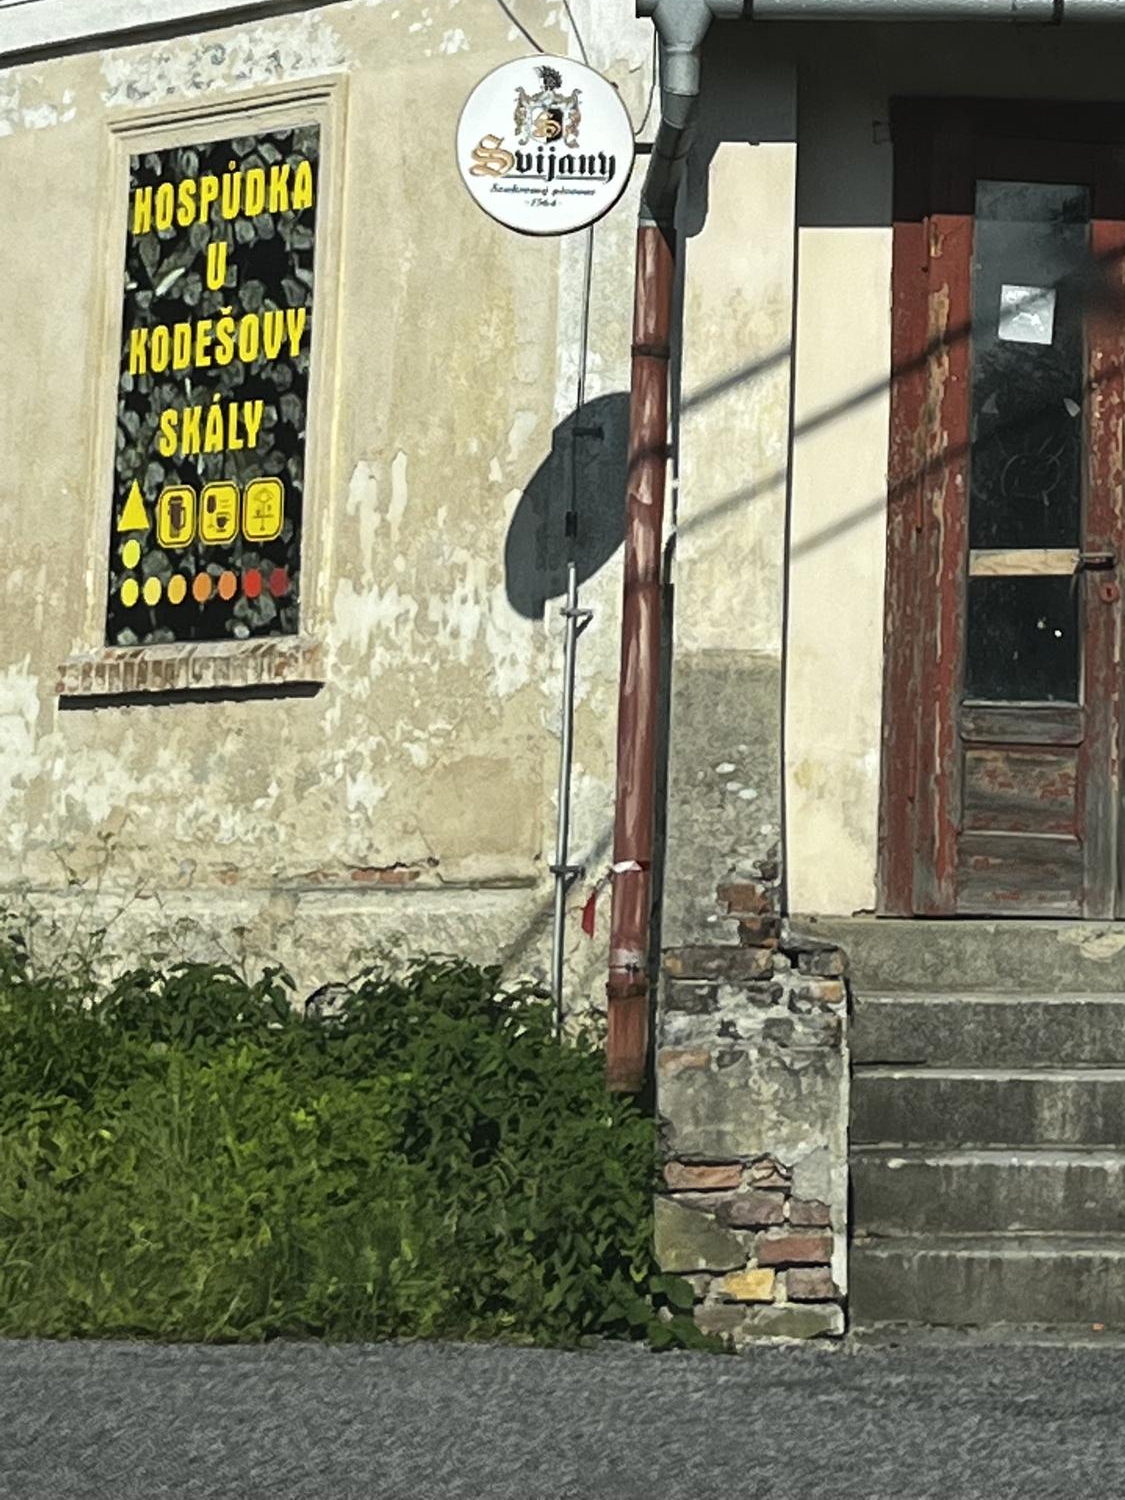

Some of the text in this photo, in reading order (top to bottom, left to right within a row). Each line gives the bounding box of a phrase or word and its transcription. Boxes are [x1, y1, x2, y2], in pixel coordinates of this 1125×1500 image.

[468, 133, 617, 185] Svijany
[206, 241, 228, 291] U
[129, 305, 306, 376] KODEŠOVY
[159, 392, 264, 458] SKÁLY
